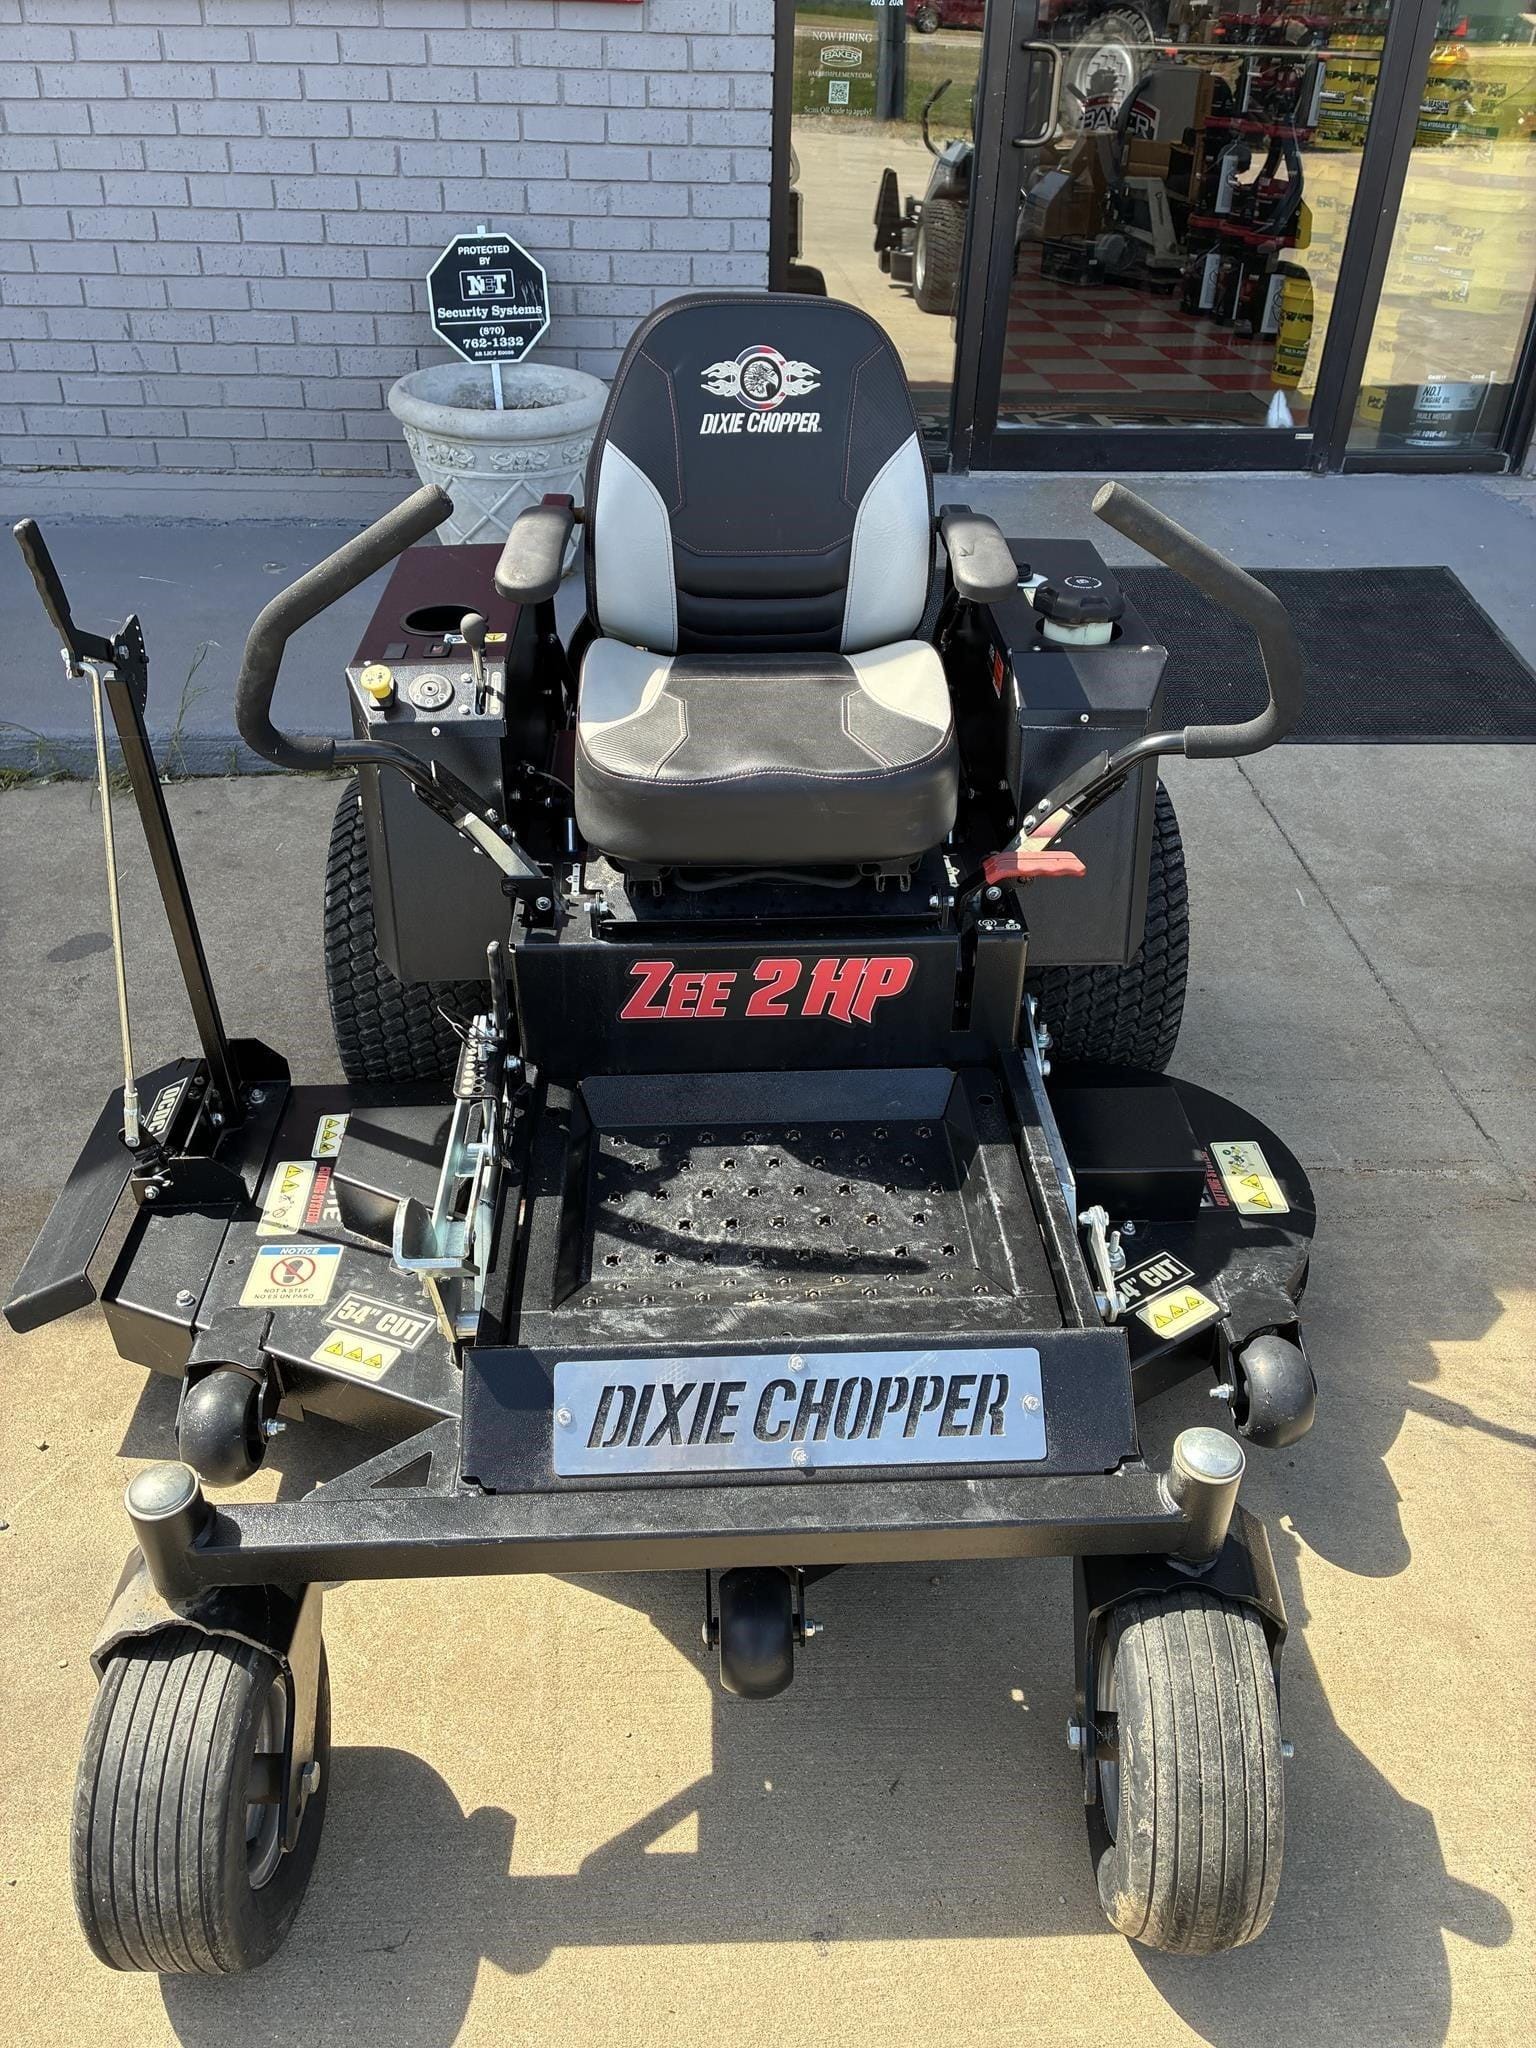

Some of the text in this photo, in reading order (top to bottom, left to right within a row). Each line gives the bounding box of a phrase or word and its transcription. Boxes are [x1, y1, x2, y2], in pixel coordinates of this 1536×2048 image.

[812, 31, 873, 43] NOW HIRING
[824, 50, 859, 61] BAKER
[820, 105, 831, 114] QR
[458, 245, 510, 255] PROTECTED
[479, 257, 491, 265] BY
[437, 304, 543, 319] Security Systems
[479, 325, 505, 336] (870)
[462, 336, 524, 349] 762-1332
[700, 412, 821, 434] DIXIE CHOPPER
[745, 958, 803, 1016] 2
[801, 956, 915, 1024] HP
[279, 1247, 321, 1255] NOTICE
[1139, 1258, 1183, 1288] CUT
[338, 1299, 425, 1341] 54" CUT
[586, 1373, 1010, 1449] DIXIE CHOPPER
